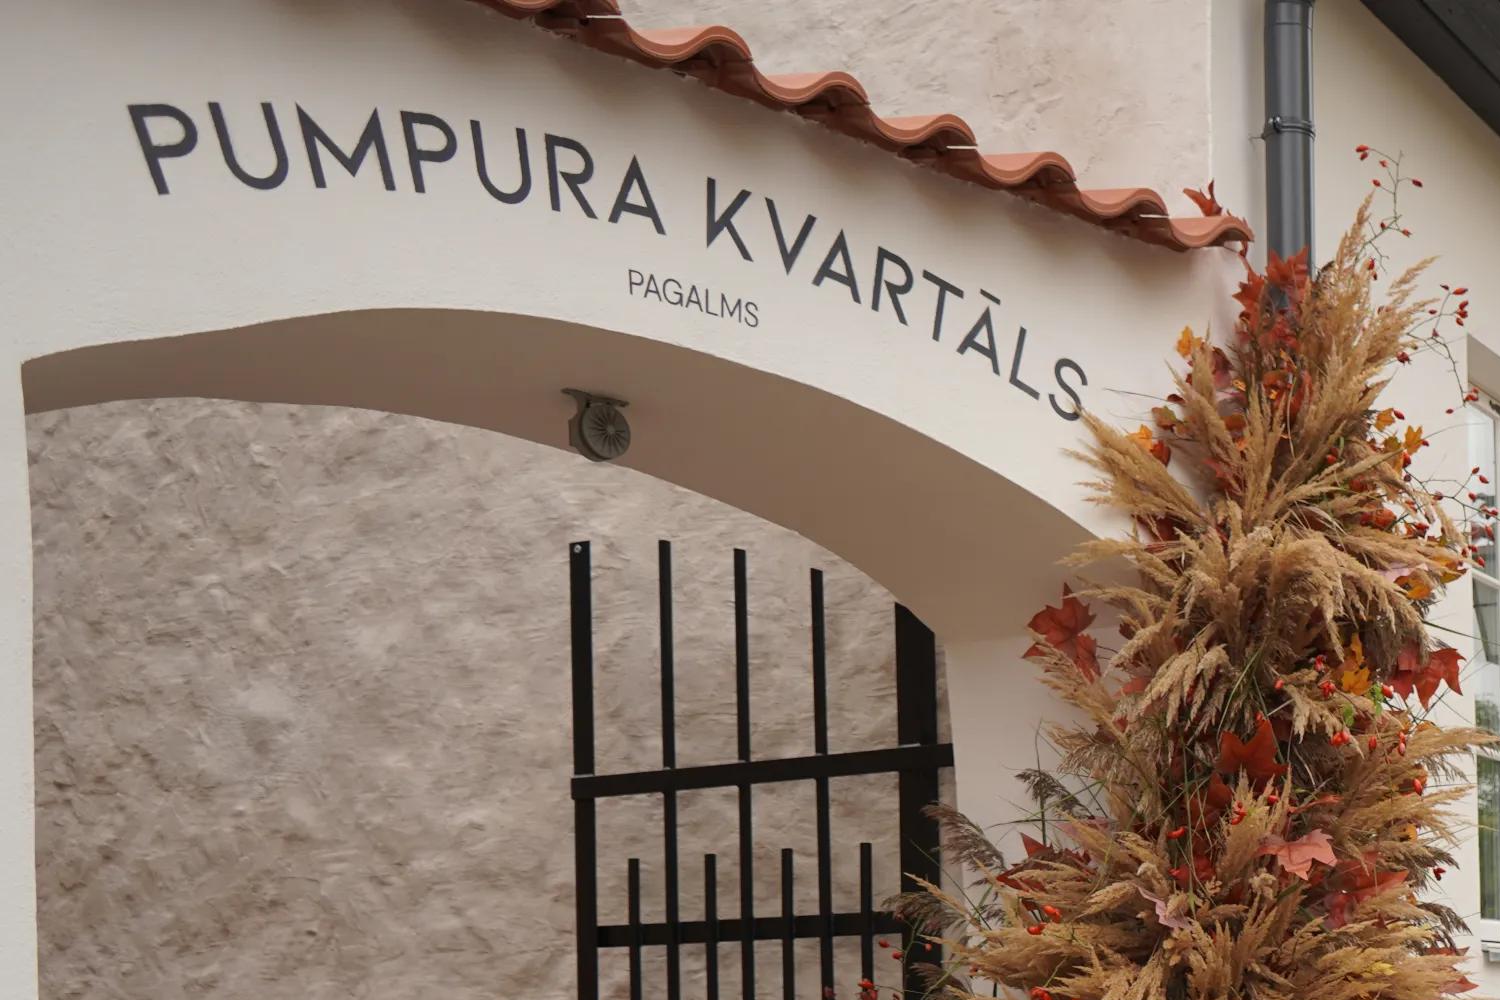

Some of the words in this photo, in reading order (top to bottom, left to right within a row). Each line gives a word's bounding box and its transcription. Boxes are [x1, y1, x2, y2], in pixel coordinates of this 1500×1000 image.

[127, 102, 666, 236] PUMPURA
[706, 176, 1088, 422] KVARTĀLS
[628, 269, 759, 328] PAGALMS
